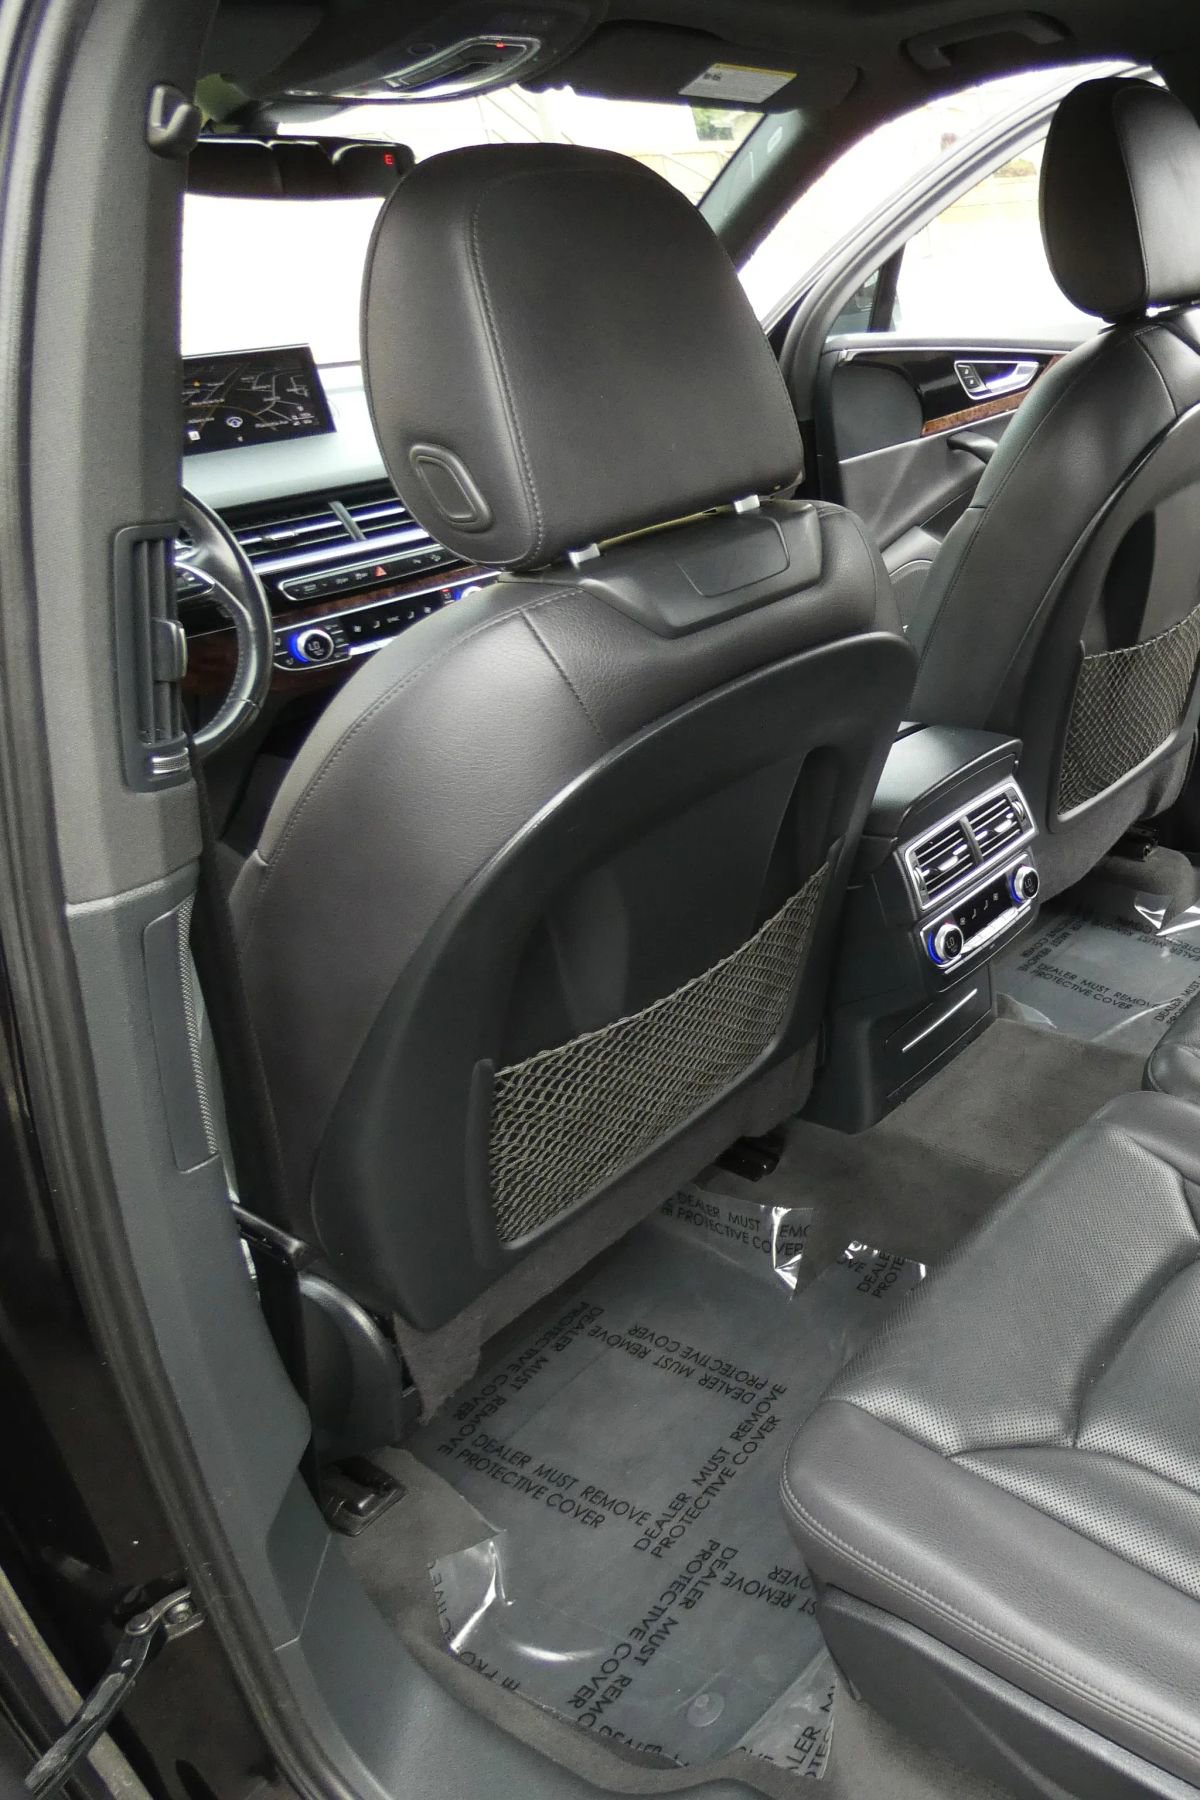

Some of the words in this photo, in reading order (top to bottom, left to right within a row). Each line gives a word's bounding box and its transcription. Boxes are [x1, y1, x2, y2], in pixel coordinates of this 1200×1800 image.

[1030, 969, 1093, 997] PROTECTIVE
[1093, 993, 1133, 1010] COVER
[1037, 962, 1078, 980] DEALER
[1080, 979, 1111, 994] MUST
[677, 1191, 721, 1217] DEALER
[728, 1212, 761, 1232] MUST
[677, 1207, 750, 1244] PROTECTIVE
[552, 1306, 605, 1352] DEALER
[588, 1325, 652, 1360] REMOVE
[628, 1323, 681, 1351] COVER
[510, 1356, 549, 1391] MUST
[652, 1354, 695, 1378] MUST
[679, 1345, 769, 1391] PROTECTIVE
[698, 1373, 756, 1405] DEALER
[453, 1374, 508, 1421] COVER
[437, 1395, 507, 1456] REMOVE
[456, 1449, 549, 1500] PROTECTIVE
[546, 1492, 606, 1529] COVER
[472, 1433, 532, 1468] DEALER
[533, 1464, 580, 1490] MUST
[580, 1485, 652, 1527] REMOVE
[632, 1492, 692, 1551] DEALER
[691, 1446, 731, 1486] MUST
[729, 1383, 788, 1442] REMOVE
[650, 1466, 737, 1559] PROTECTIVE
[732, 1415, 781, 1465] COVER
[629, 1539, 720, 1641] PROTECTIVE
[678, 1546, 739, 1610] DEALER
[720, 1571, 797, 1608] REMOVE
[634, 1616, 679, 1667] MUST
[567, 1643, 632, 1709] COVER
